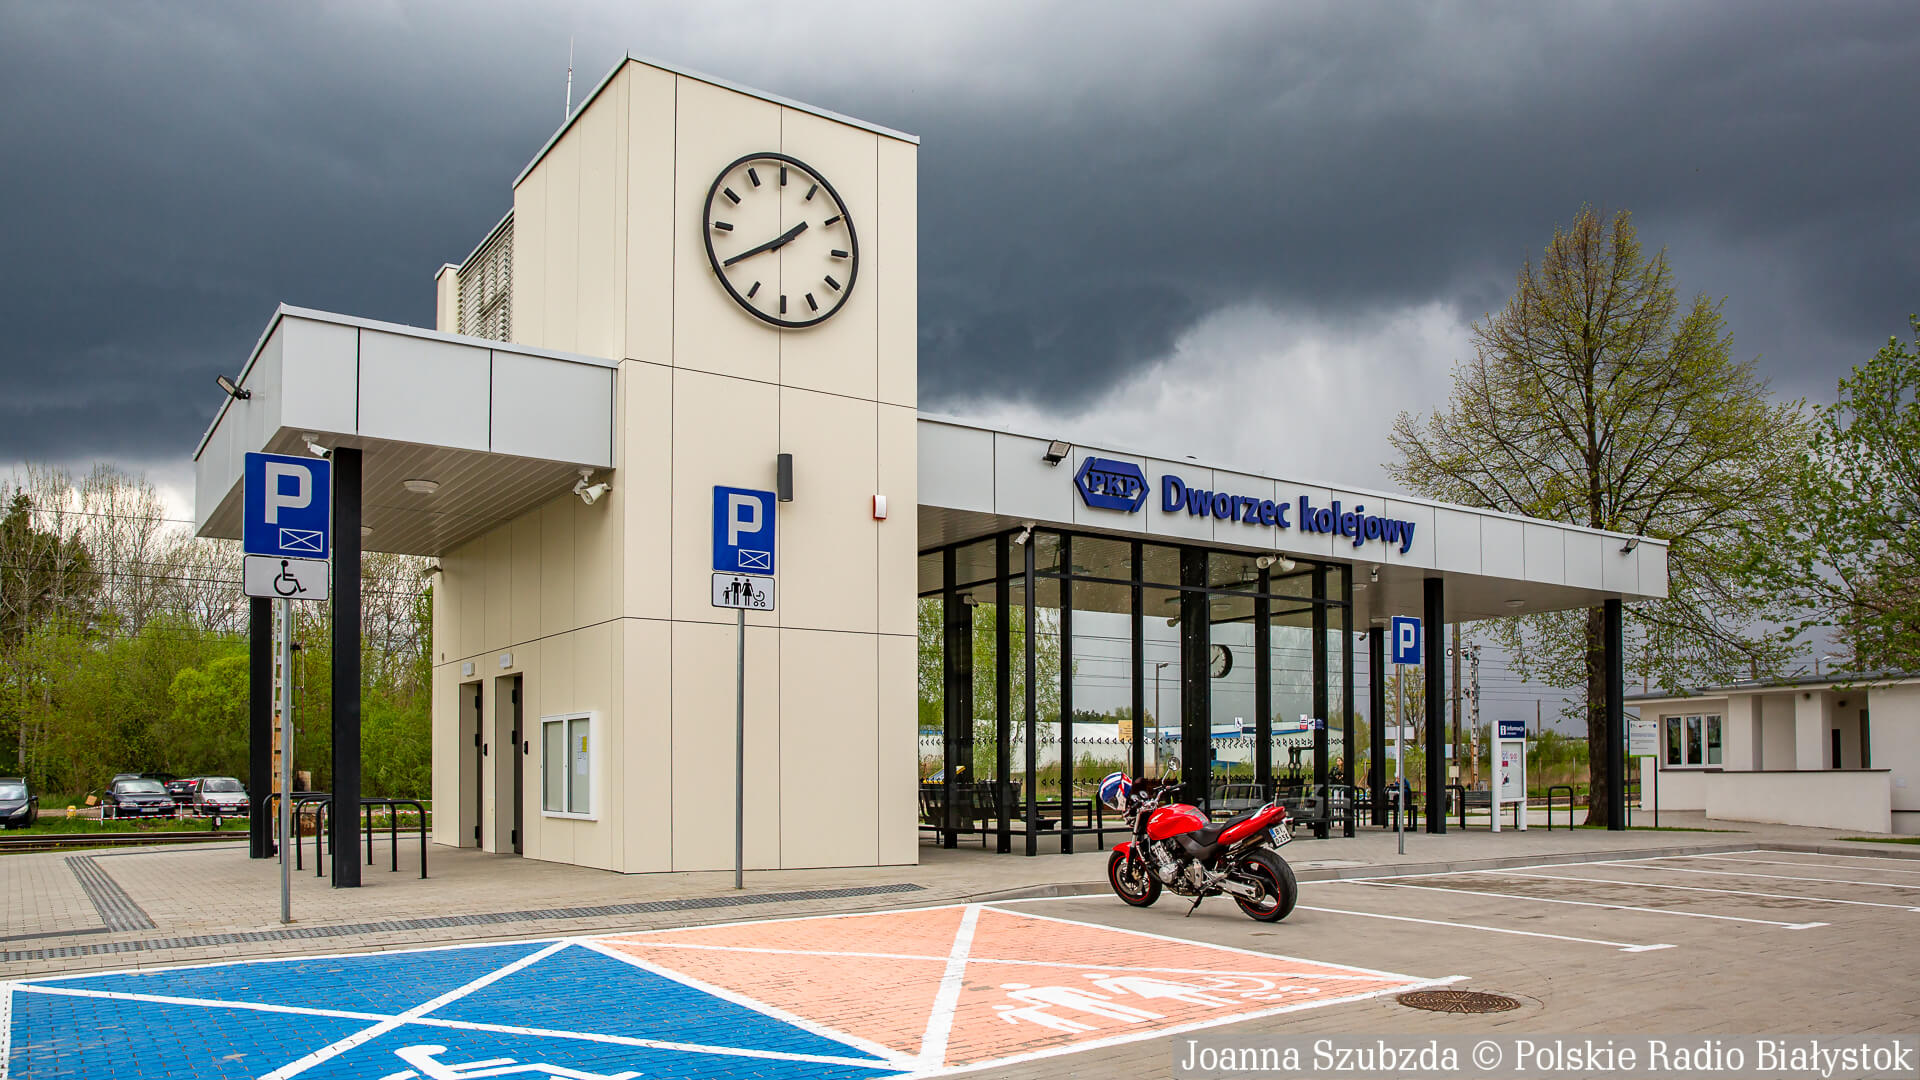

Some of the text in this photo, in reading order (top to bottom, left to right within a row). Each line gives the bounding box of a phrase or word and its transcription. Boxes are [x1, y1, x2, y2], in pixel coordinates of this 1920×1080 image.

[264, 461, 312, 525] P
[1088, 471, 1140, 498] PKP
[727, 492, 763, 546] P
[1161, 474, 1416, 554] Dworzec kolejowy
[1399, 622, 1415, 658] P
